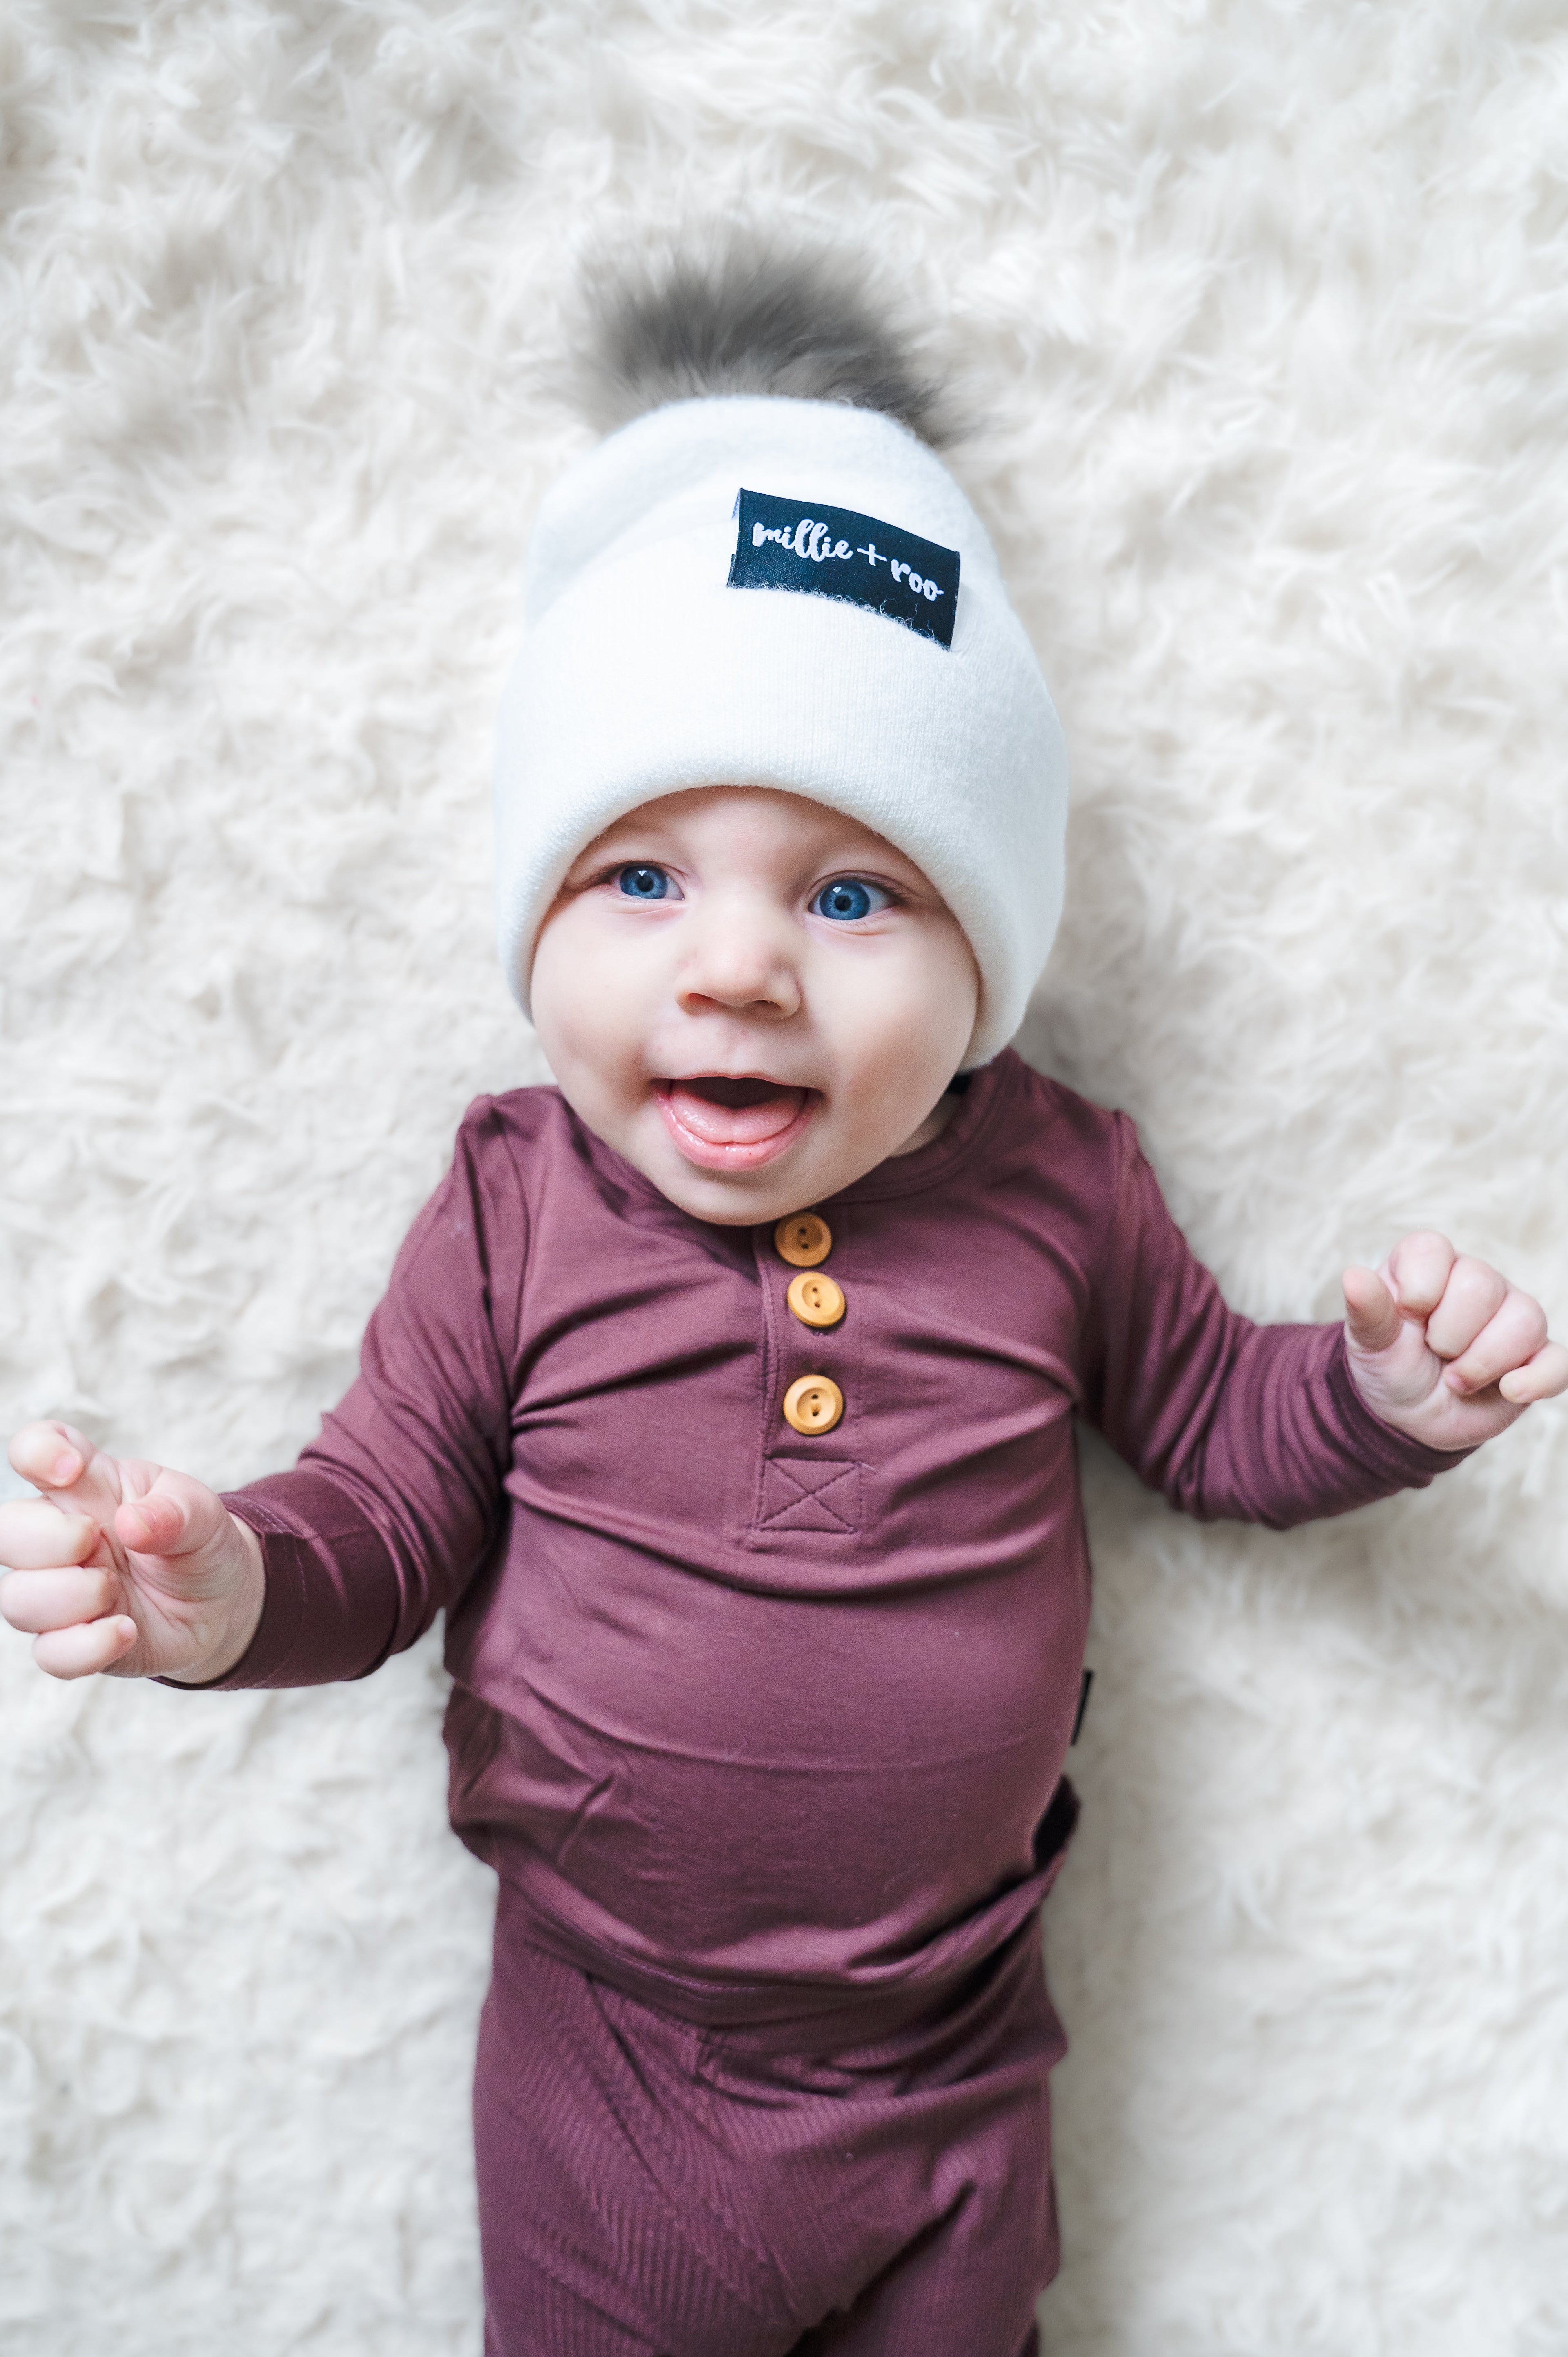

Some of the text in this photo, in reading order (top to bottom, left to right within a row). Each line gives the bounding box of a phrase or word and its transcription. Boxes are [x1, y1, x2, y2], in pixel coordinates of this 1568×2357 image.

[752, 519, 944, 602] millie + roo
